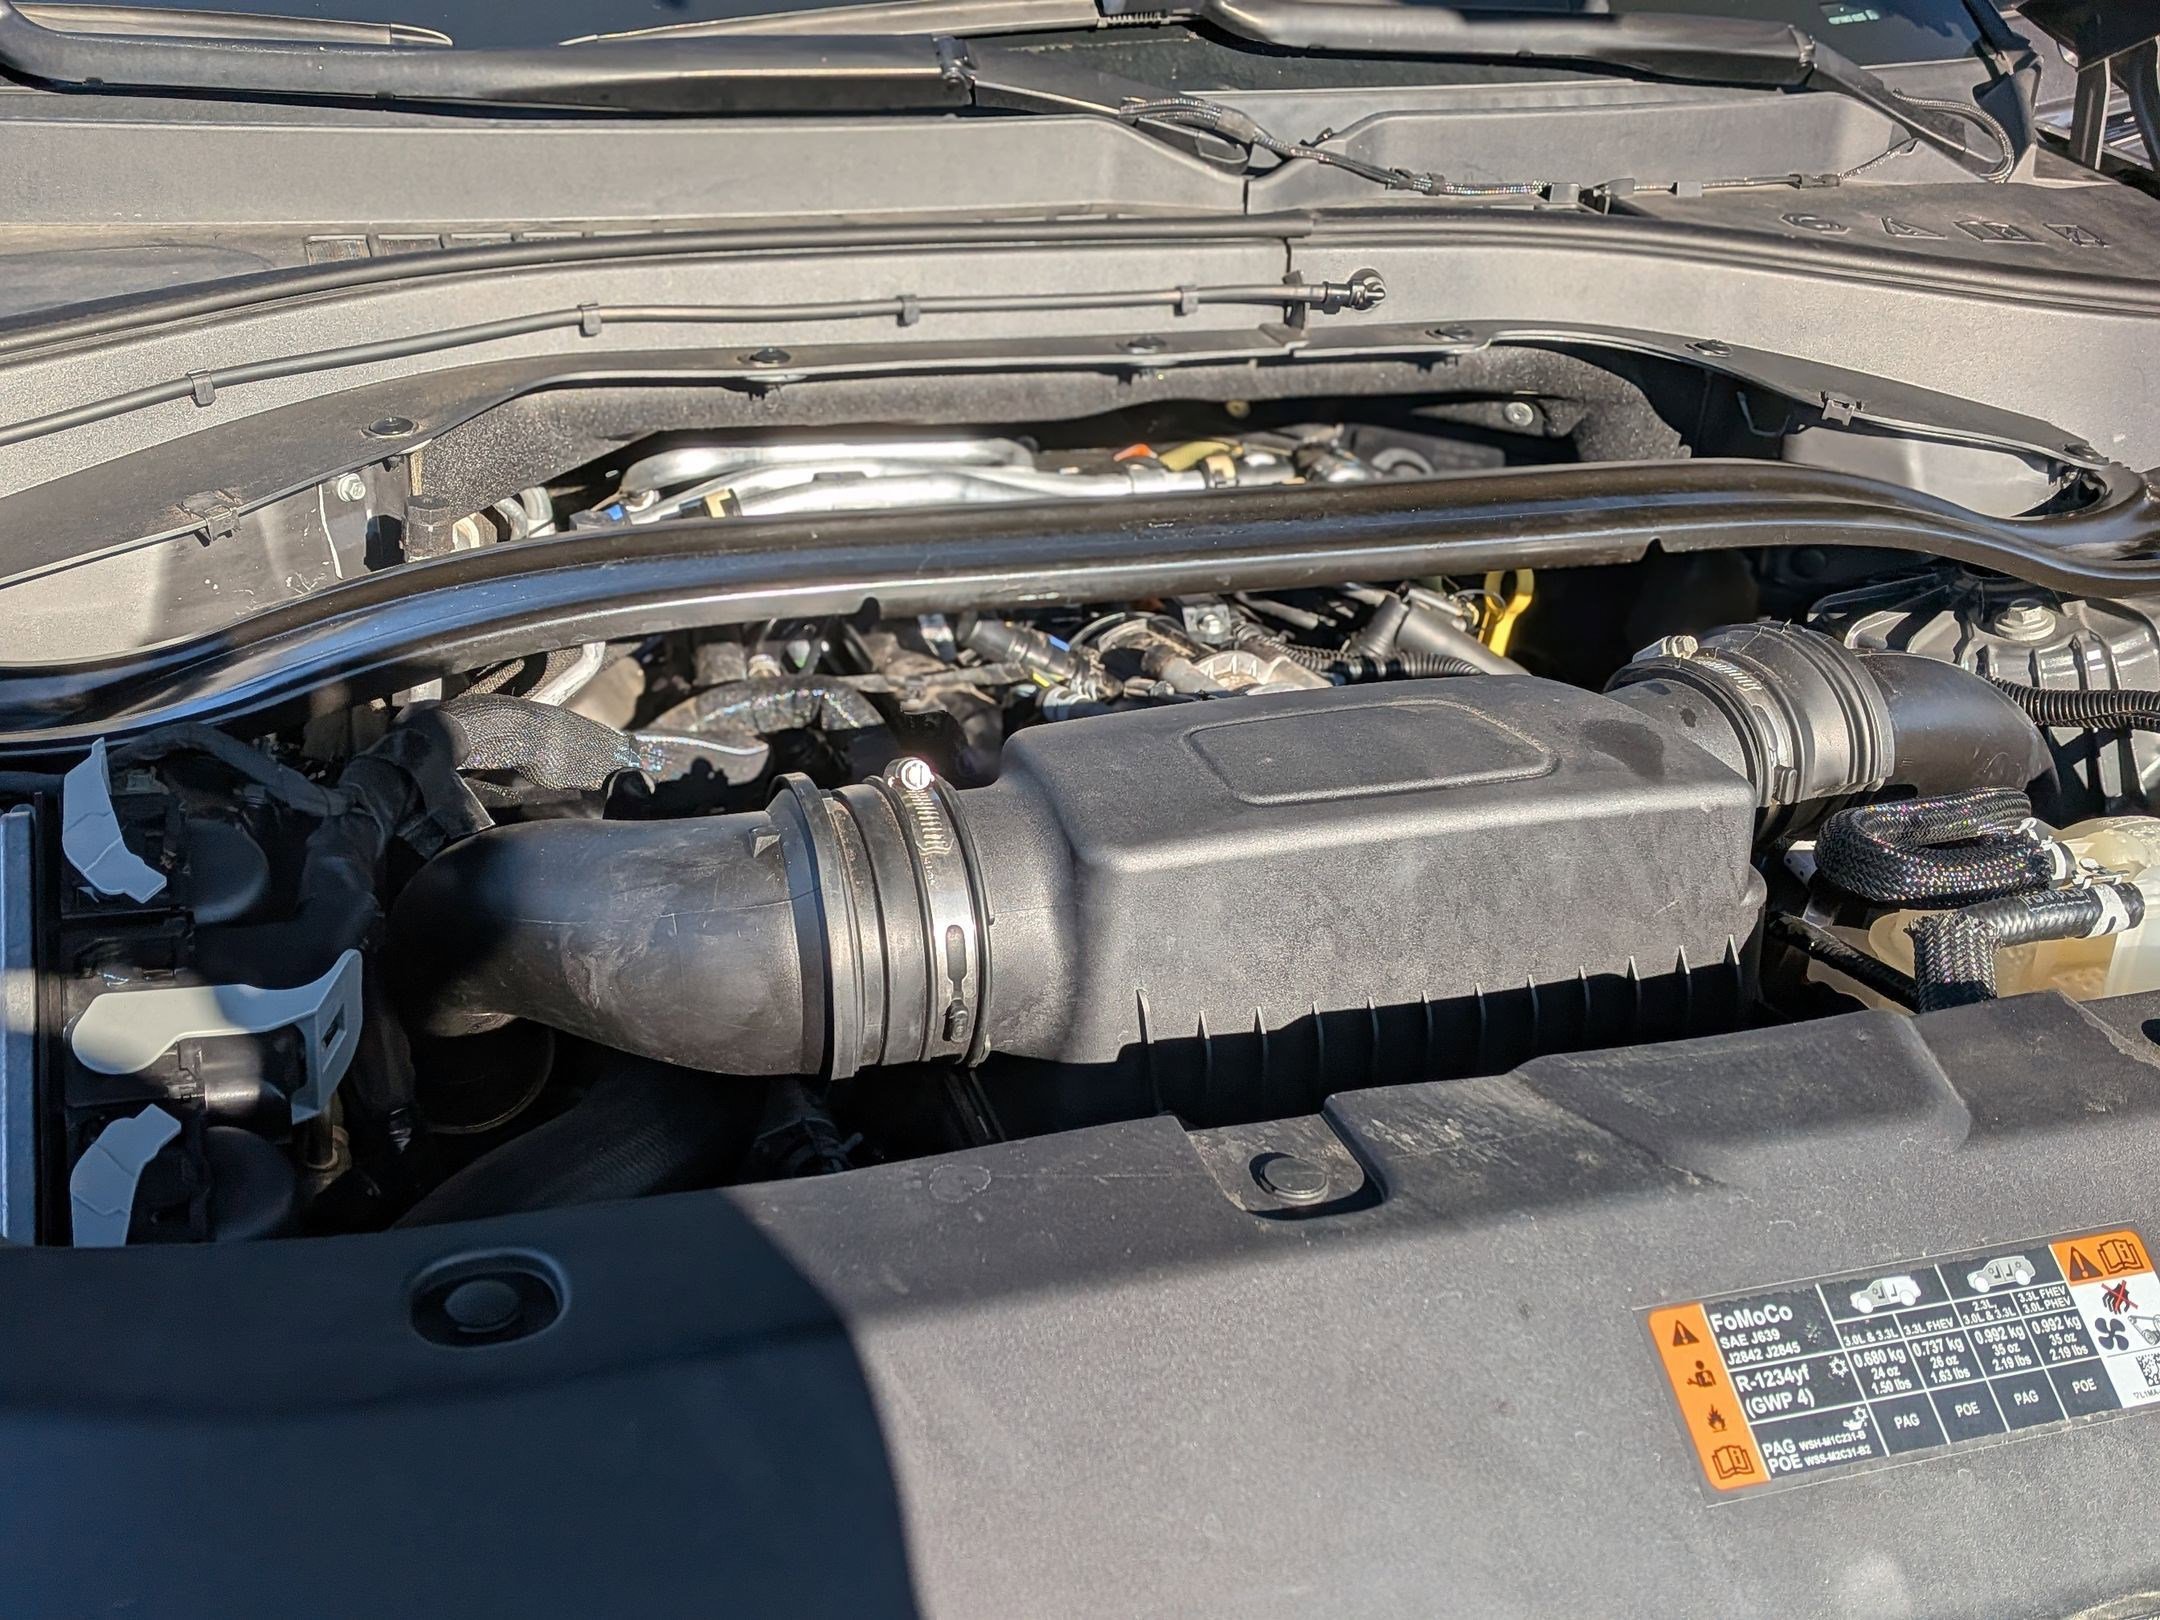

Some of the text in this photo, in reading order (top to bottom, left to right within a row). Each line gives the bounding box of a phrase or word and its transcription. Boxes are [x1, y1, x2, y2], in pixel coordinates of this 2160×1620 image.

[2018, 1285, 2066, 1303] 3.3L FHEV
[2022, 1296, 2072, 1314] 3.0L PHEV
[1710, 1304, 1793, 1332] FoMoCo
[1963, 1307, 2016, 1325] 3.0L & 3.3L
[2031, 1314, 2082, 1334] 0.992 kg
[1904, 1317, 1954, 1336] 3.3L FHEV
[1974, 1324, 2026, 1344] 0.992 kg
[1720, 1328, 1780, 1349] SAE J639
[1844, 1328, 1898, 1346] 3.0L & 3.3L
[2049, 1332, 2077, 1346] 35 oz
[1727, 1341, 1800, 1365] J2842 J2845
[1912, 1337, 1964, 1357] 0.737 kg
[1992, 1342, 2021, 1356] 35 oz
[2049, 1345, 2088, 1361] 2.19 lbs
[1853, 1348, 1906, 1368] 0.680 kg
[1930, 1355, 1959, 1369] 26 oz
[1992, 1355, 2032, 1371] 2.19 lbs
[1735, 1363, 1810, 1392] R-1234yf
[1871, 1366, 1901, 1380] 24 oz
[1930, 1367, 1971, 1384] 1.63 lbs
[1871, 1378, 1912, 1395] 1.50 lbs
[2072, 1378, 2097, 1394] POE
[1746, 1388, 1815, 1418] (GWP 4)
[2014, 1390, 2039, 1406] PAG
[1955, 1402, 1980, 1418] POE
[1894, 1413, 1920, 1429] PAG
[1762, 1439, 1796, 1458] PAG
[1768, 1454, 1803, 1474] POE
